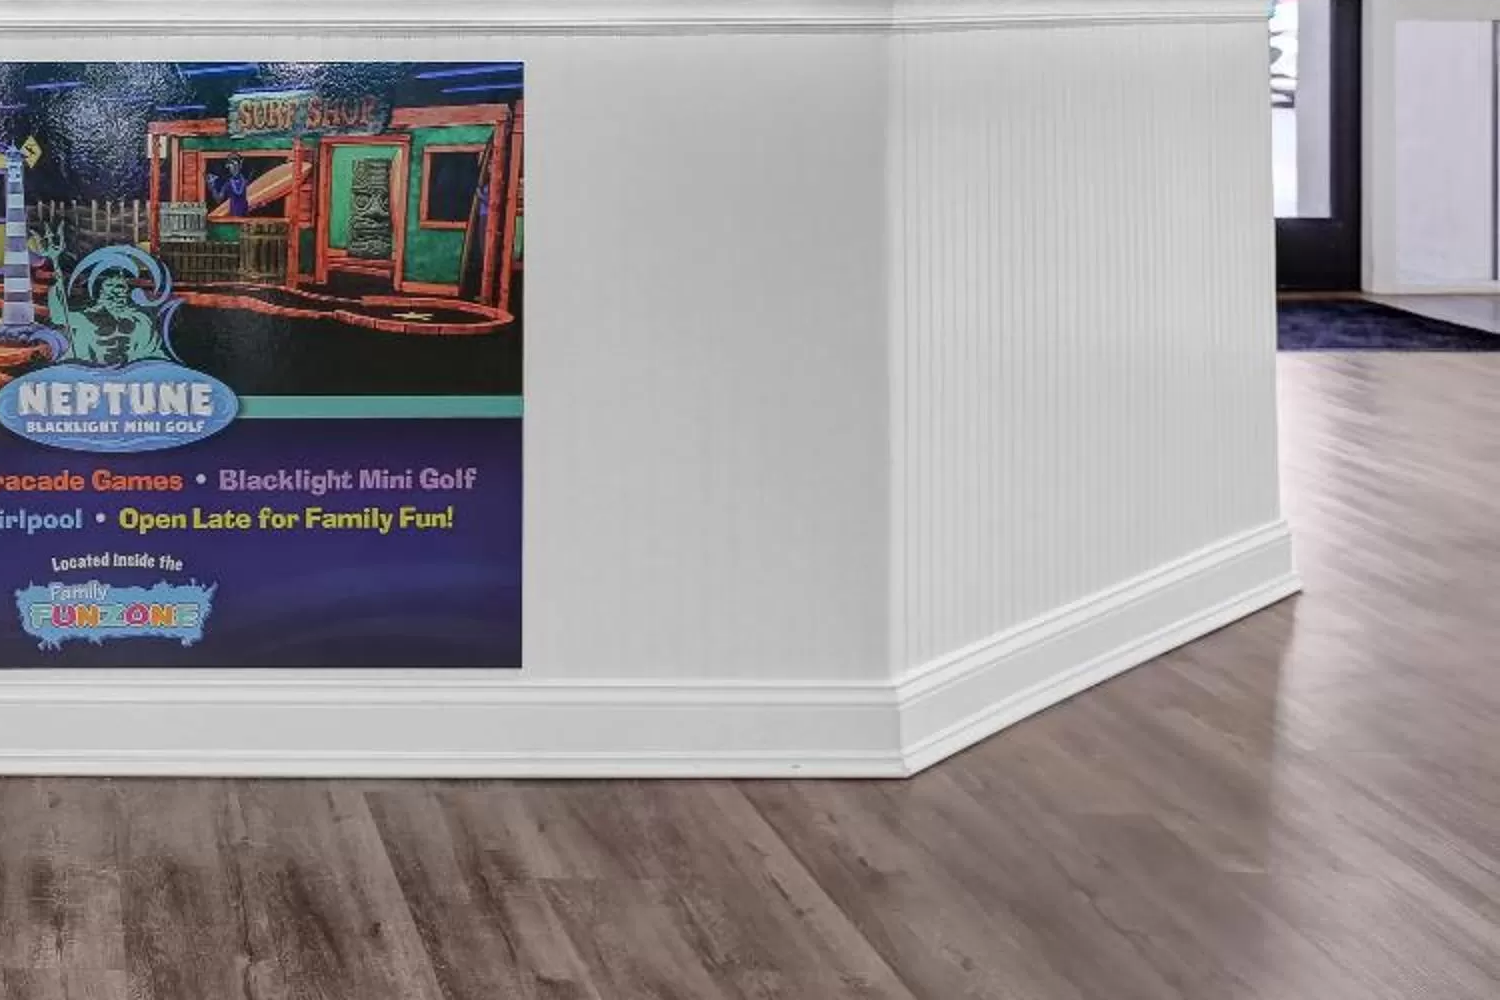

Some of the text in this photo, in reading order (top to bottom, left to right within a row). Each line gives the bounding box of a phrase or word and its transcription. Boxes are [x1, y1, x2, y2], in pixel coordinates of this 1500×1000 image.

[18, 382, 214, 416] NEPTUNE
[26, 420, 204, 433] BLACKLIGHT MINI GOLF
[92, 469, 184, 492] Games
[218, 468, 353, 496] Blacklight
[358, 468, 413, 491] Mini
[419, 467, 477, 491] Golf
[118, 507, 187, 535] Open
[192, 507, 252, 530] Late
[257, 507, 300, 530] for
[304, 507, 394, 535] Family
[399, 507, 454, 530] Fun!
[51, 552, 183, 572] Located Inside the
[51, 582, 108, 601] Family
[31, 603, 199, 628] FUNZONE
